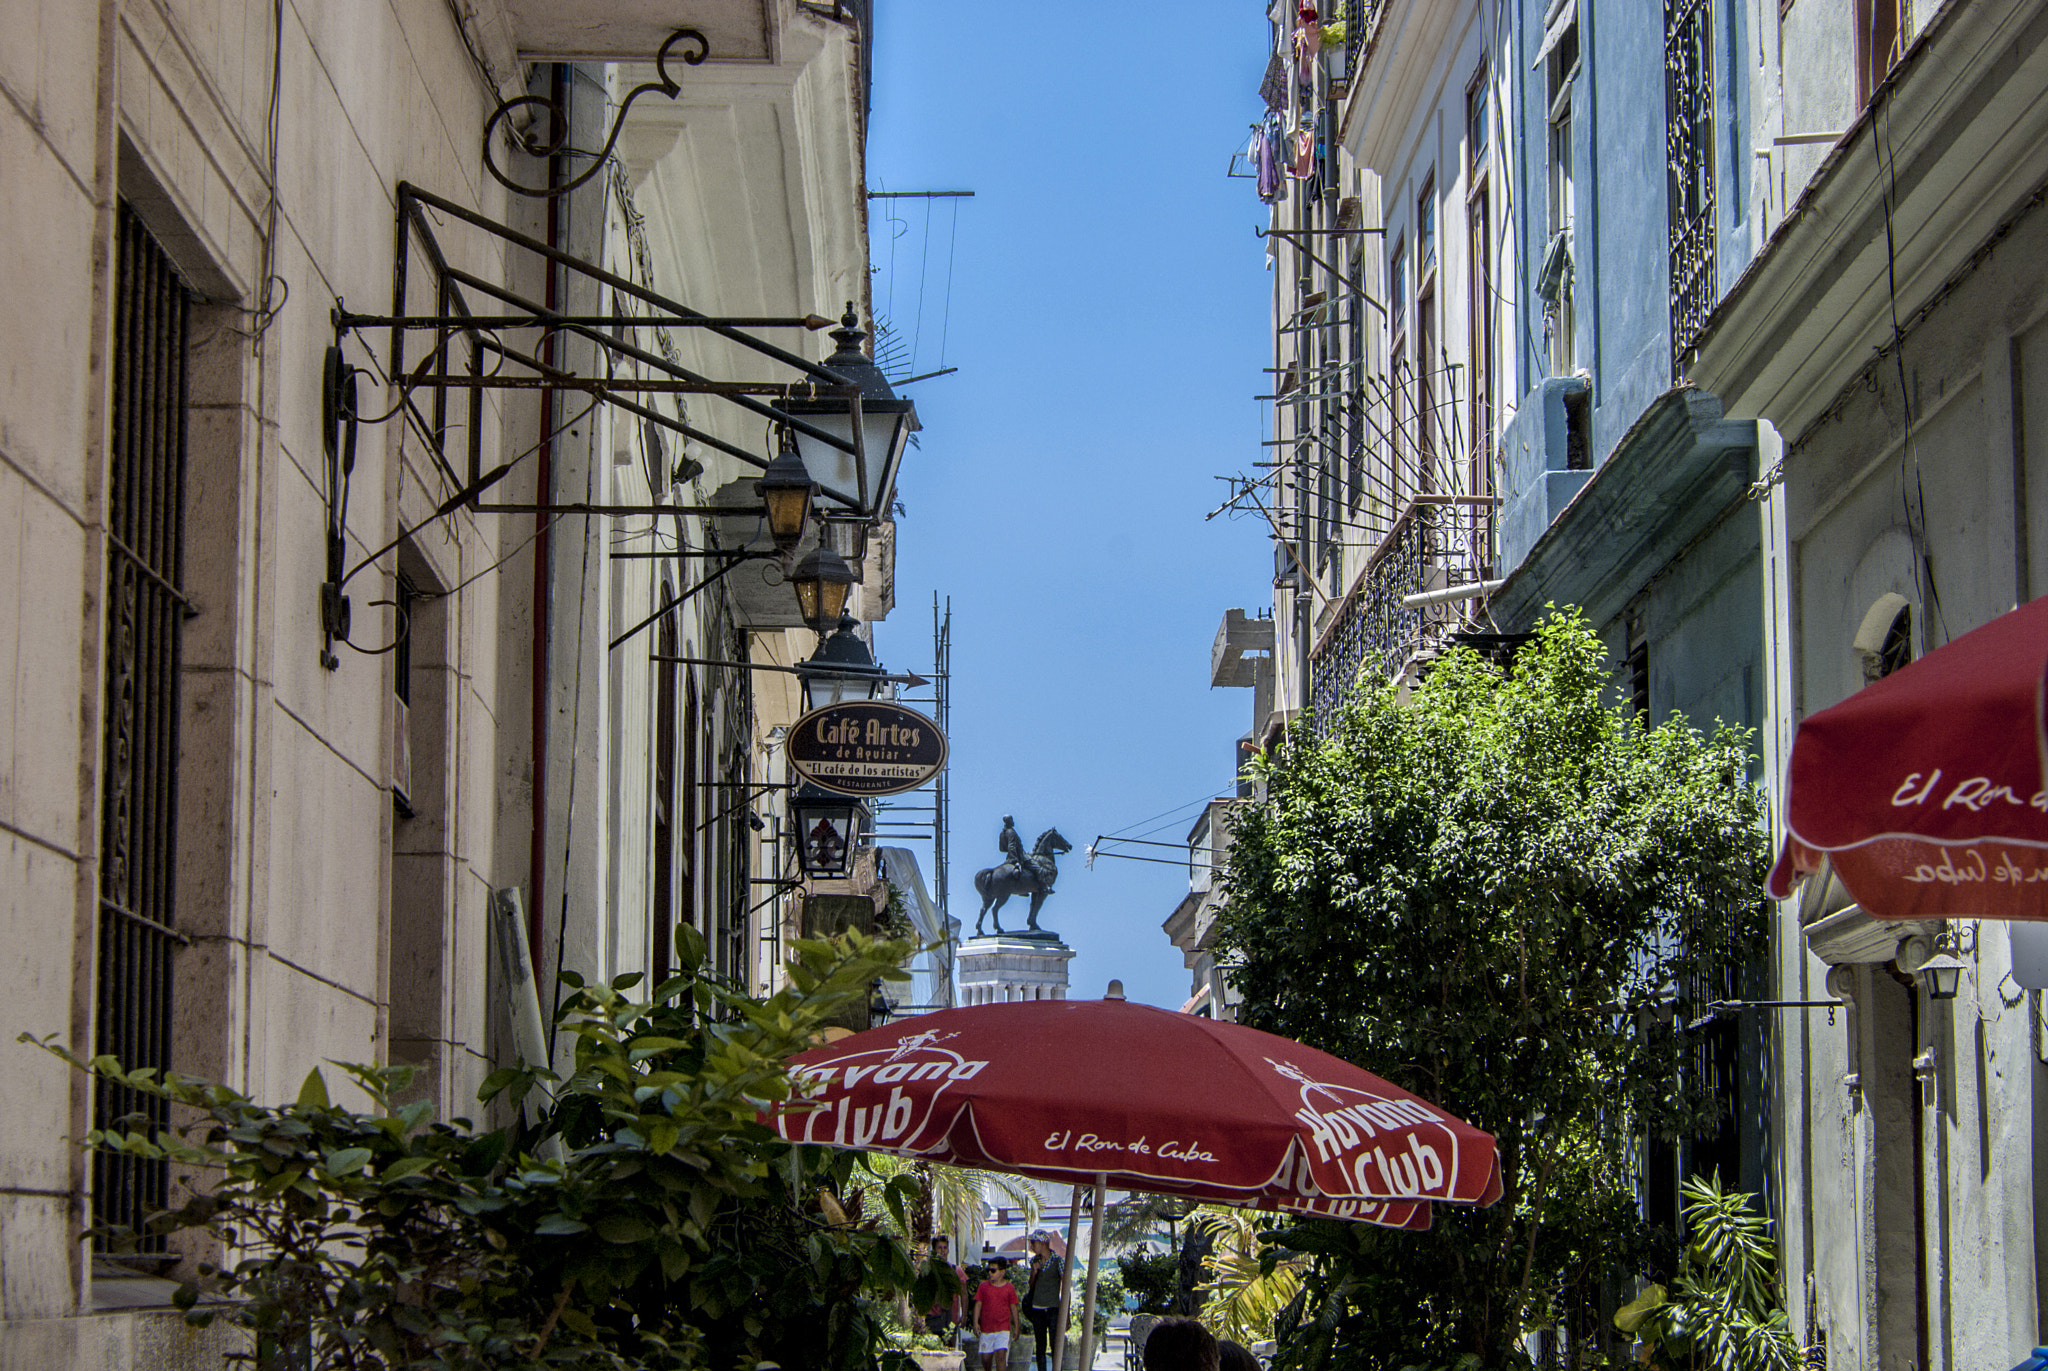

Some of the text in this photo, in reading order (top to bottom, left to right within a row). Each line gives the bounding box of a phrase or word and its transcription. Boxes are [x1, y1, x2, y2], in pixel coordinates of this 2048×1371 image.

[817, 717, 920, 748] Café Artes
[825, 763, 845, 775] café
[848, 764, 860, 775] de
[863, 764, 878, 776] los
[836, 747, 899, 761] de Aguiar
[837, 778, 892, 789] RESTAURANTE
[1891, 768, 1942, 807] El
[1942, 776, 2024, 812] Ron
[1044, 1129, 1220, 1163] El Ron de Cuba
[1294, 1099, 1446, 1164] Havana
[1354, 1131, 1444, 1198] Club
